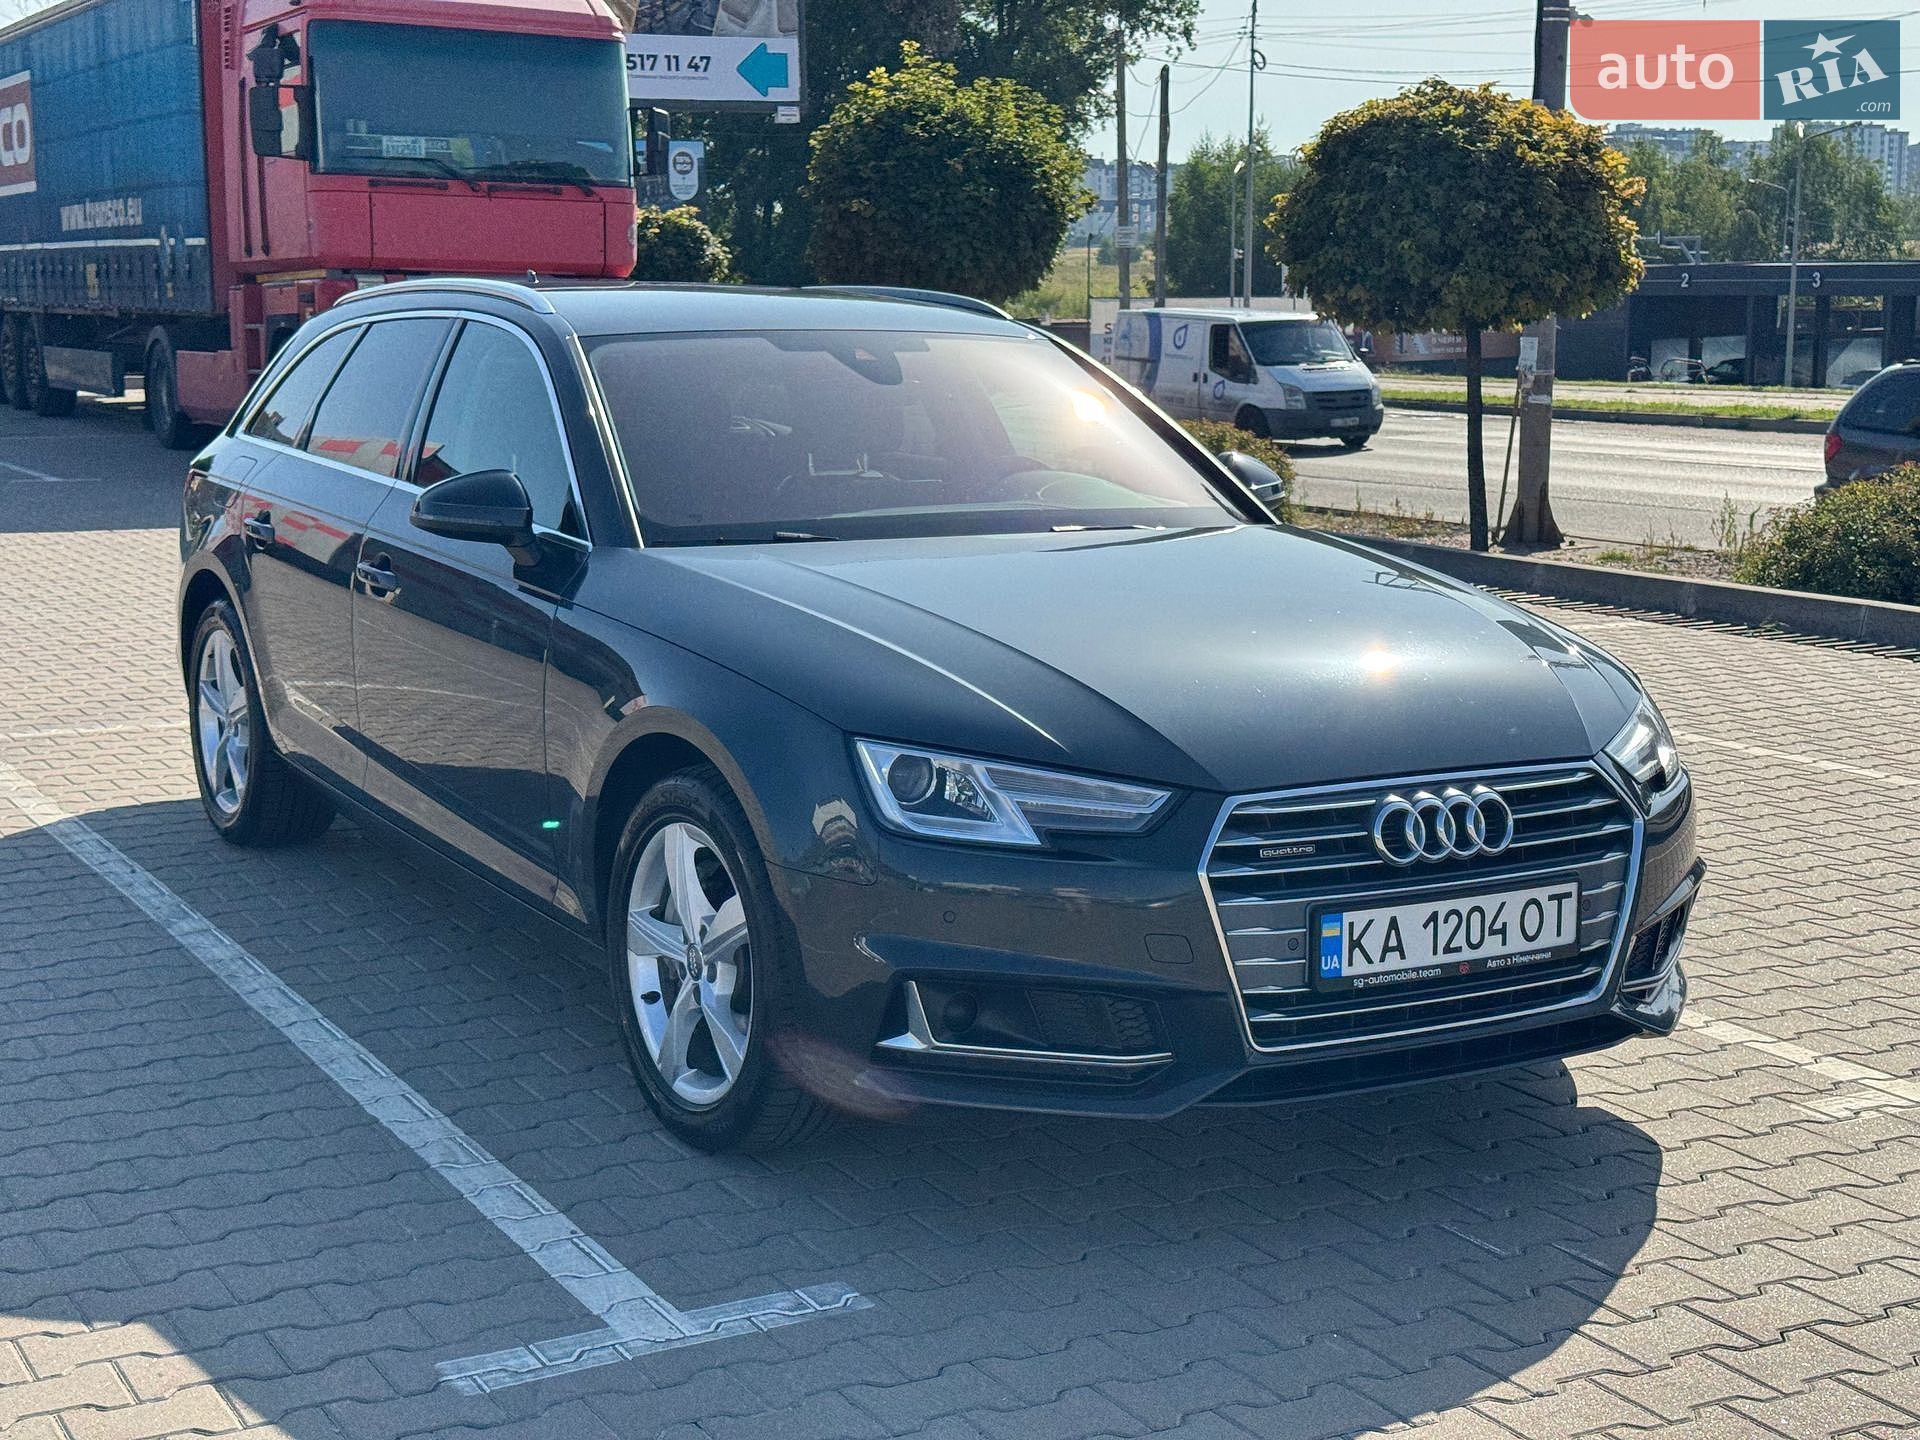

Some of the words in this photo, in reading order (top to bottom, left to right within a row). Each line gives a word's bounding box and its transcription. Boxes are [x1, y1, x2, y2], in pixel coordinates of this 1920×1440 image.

[626, 53, 658, 71] 517
[664, 54, 680, 72] 11
[687, 55, 712, 73] 47
[1681, 273, 1690, 289] 2
[1812, 272, 1821, 288] 3
[1263, 846, 1313, 857] quattro
[1347, 915, 1407, 968] KA
[1422, 900, 1507, 957] 1204
[1519, 891, 1573, 943] OT
[1321, 954, 1340, 971] UA
[1353, 967, 1442, 988] sg-automobile.team
